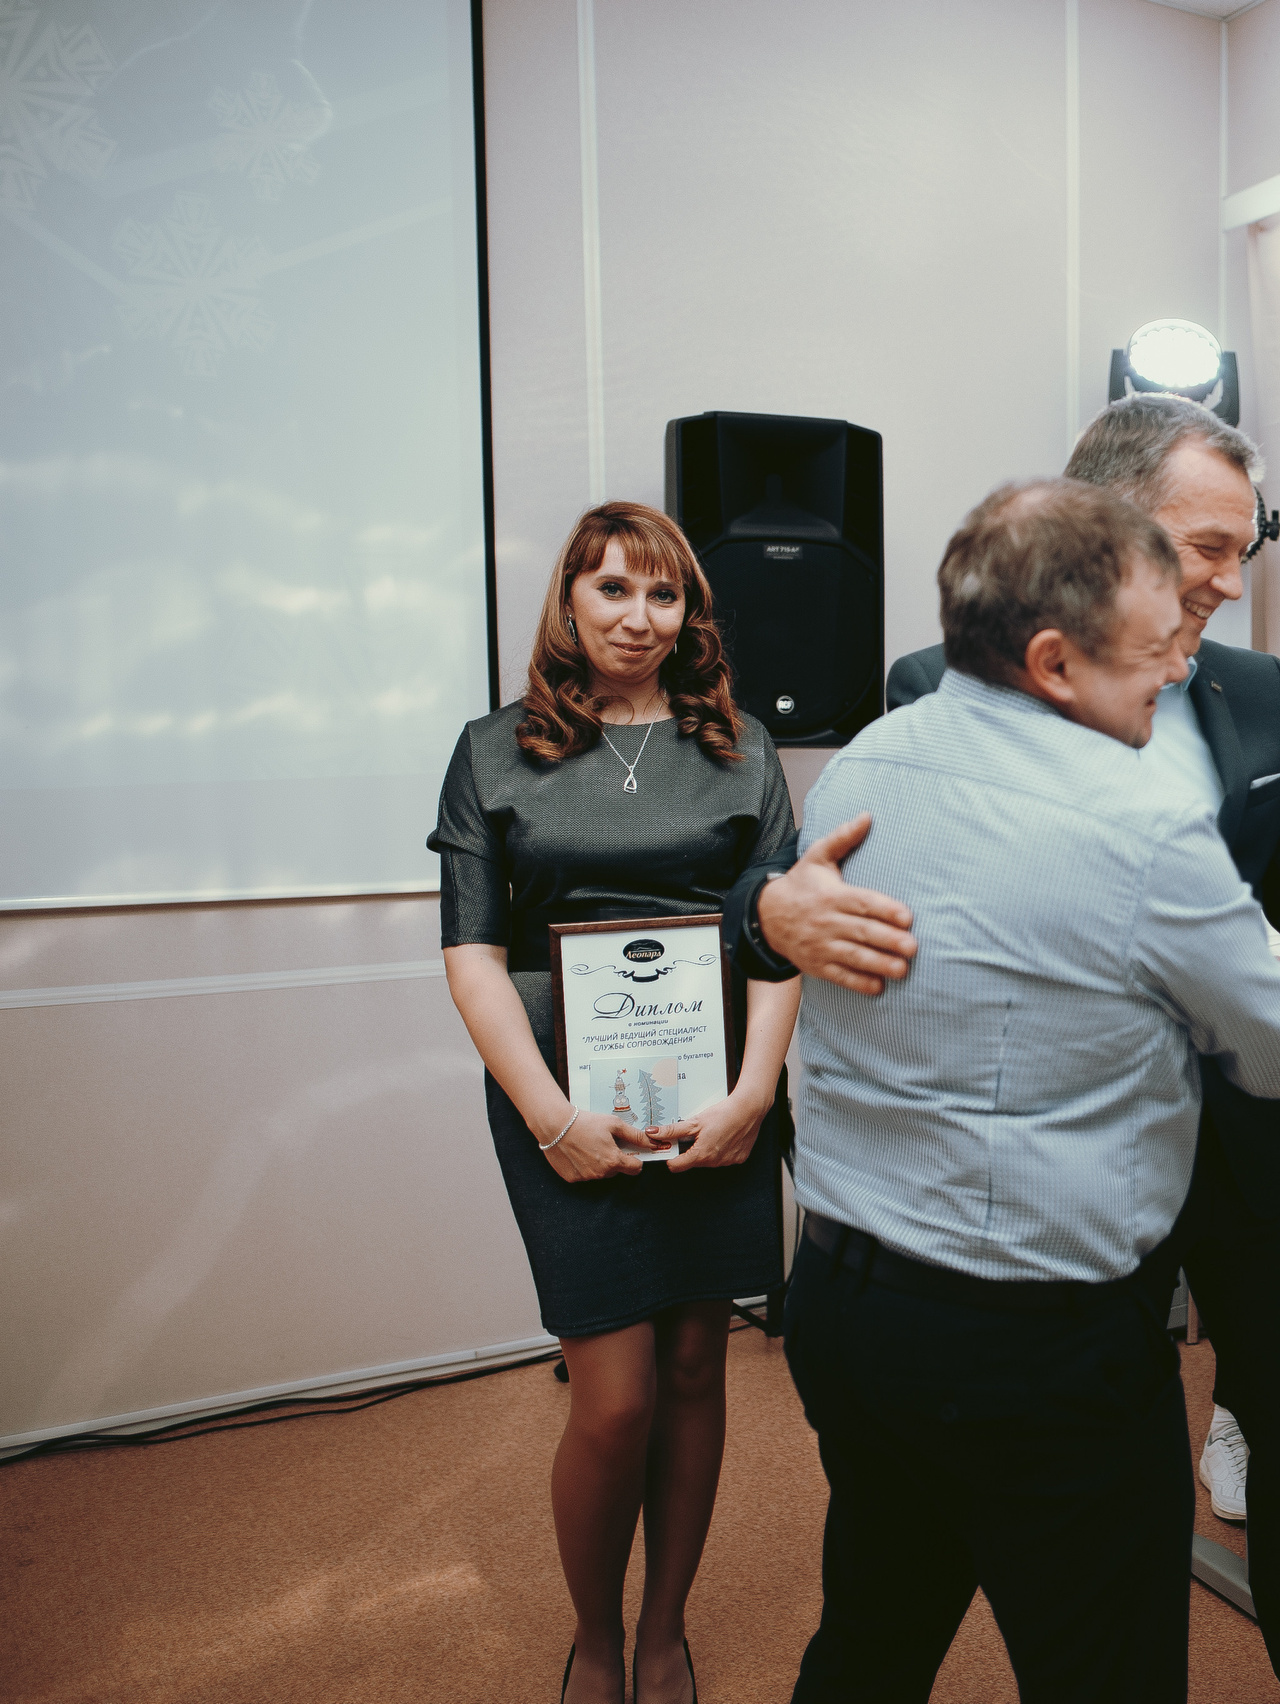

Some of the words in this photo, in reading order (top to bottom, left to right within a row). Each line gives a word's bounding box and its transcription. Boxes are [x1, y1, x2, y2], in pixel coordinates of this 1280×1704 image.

[625, 950, 662, 960] Леопард
[591, 992, 703, 1021] Диплом
[633, 1019, 669, 1027] номинации
[620, 1029, 656, 1040] ВЕДУЩИЙ
[658, 1025, 707, 1037] СПЕЦИАЛИСТ
[593, 1041, 624, 1052] СЛУЖБЫ
[683, 1052, 714, 1061] бухгалтера
